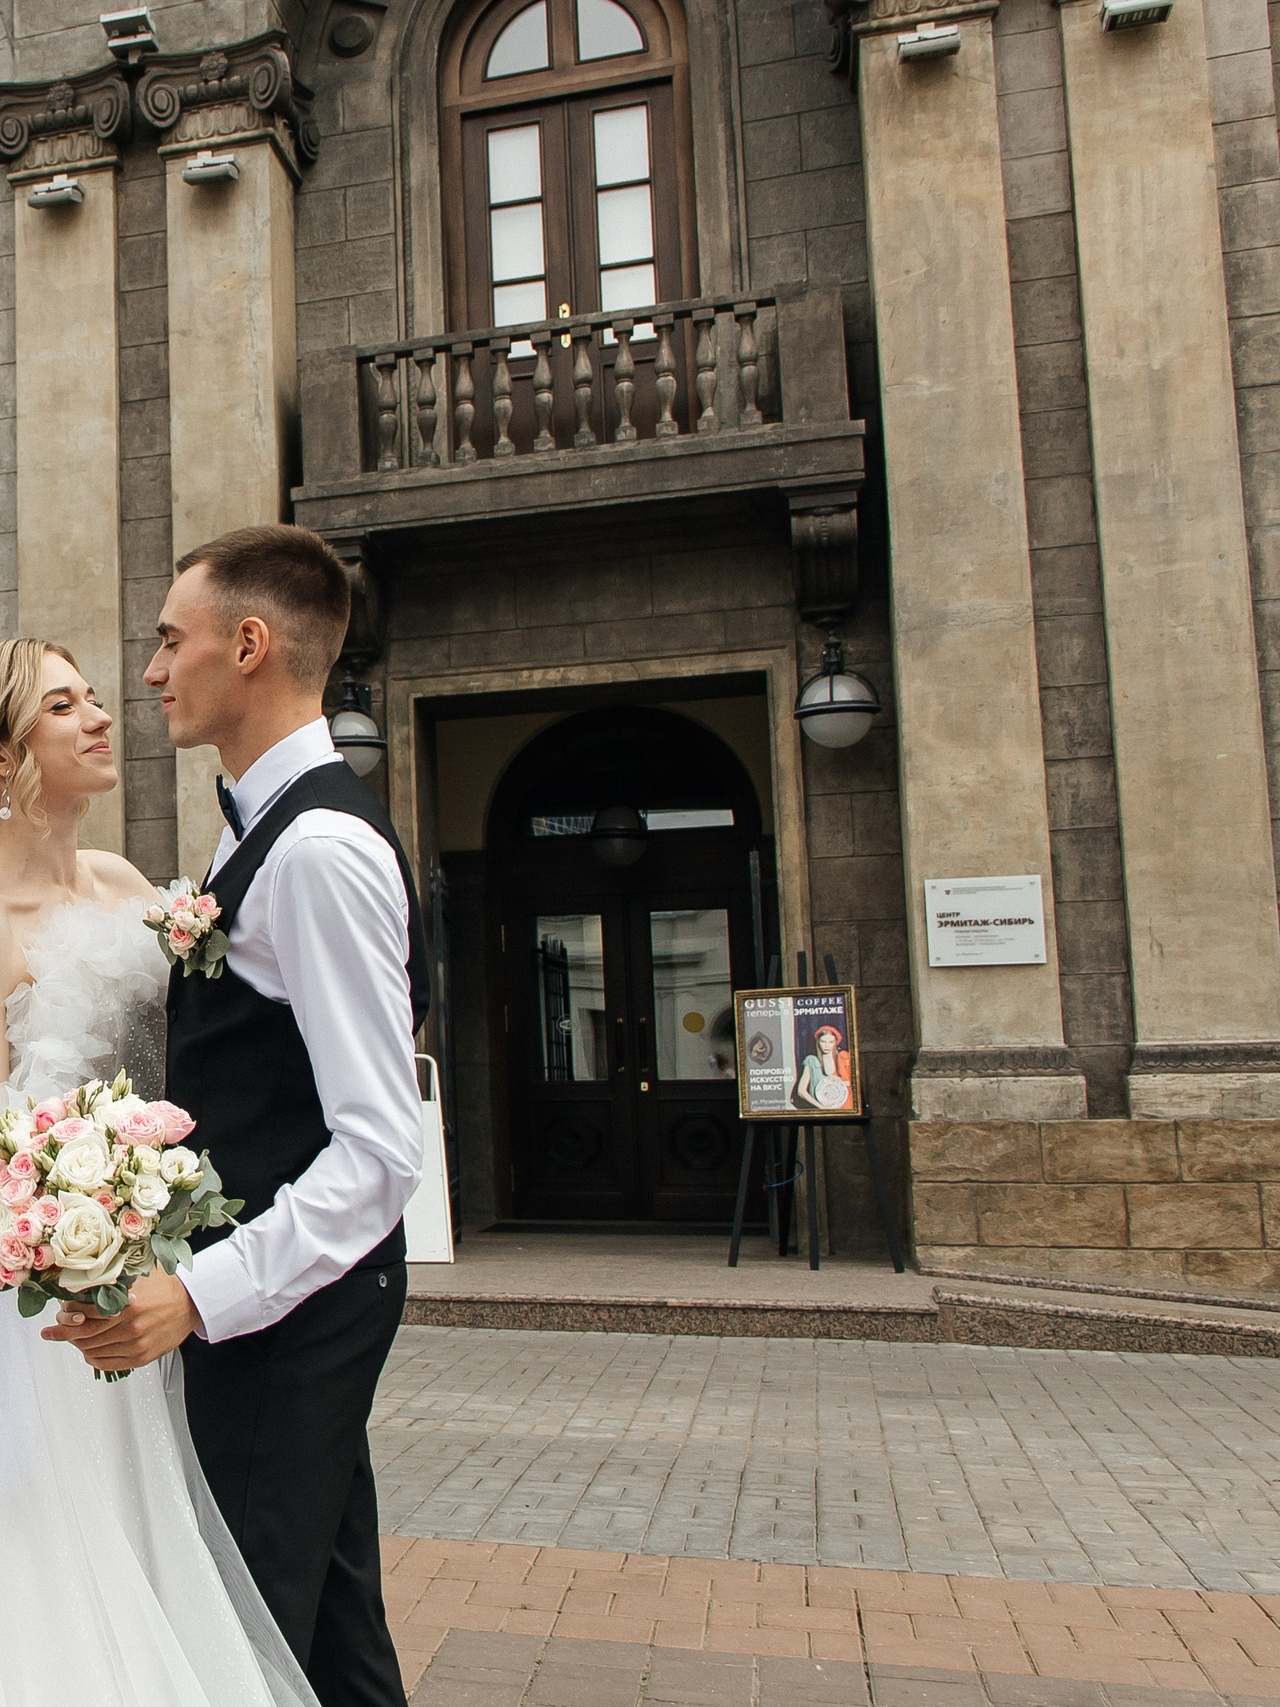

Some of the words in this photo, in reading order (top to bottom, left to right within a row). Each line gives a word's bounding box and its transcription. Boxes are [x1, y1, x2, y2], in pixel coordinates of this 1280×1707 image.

[937, 918, 1035, 928] ЭРМИТАЖ-СИБИРЬ
[744, 997, 791, 1009] GUSSI
[797, 996, 843, 1006] COFFEE
[746, 1009, 781, 1018] теперь
[793, 1006, 844, 1016] ЭРМИТАЖЕ
[749, 1067, 792, 1076] ПОПРОБУЙ
[749, 1075, 794, 1084] ИСКУССТВО
[763, 1083, 783, 1091] ВКУС
